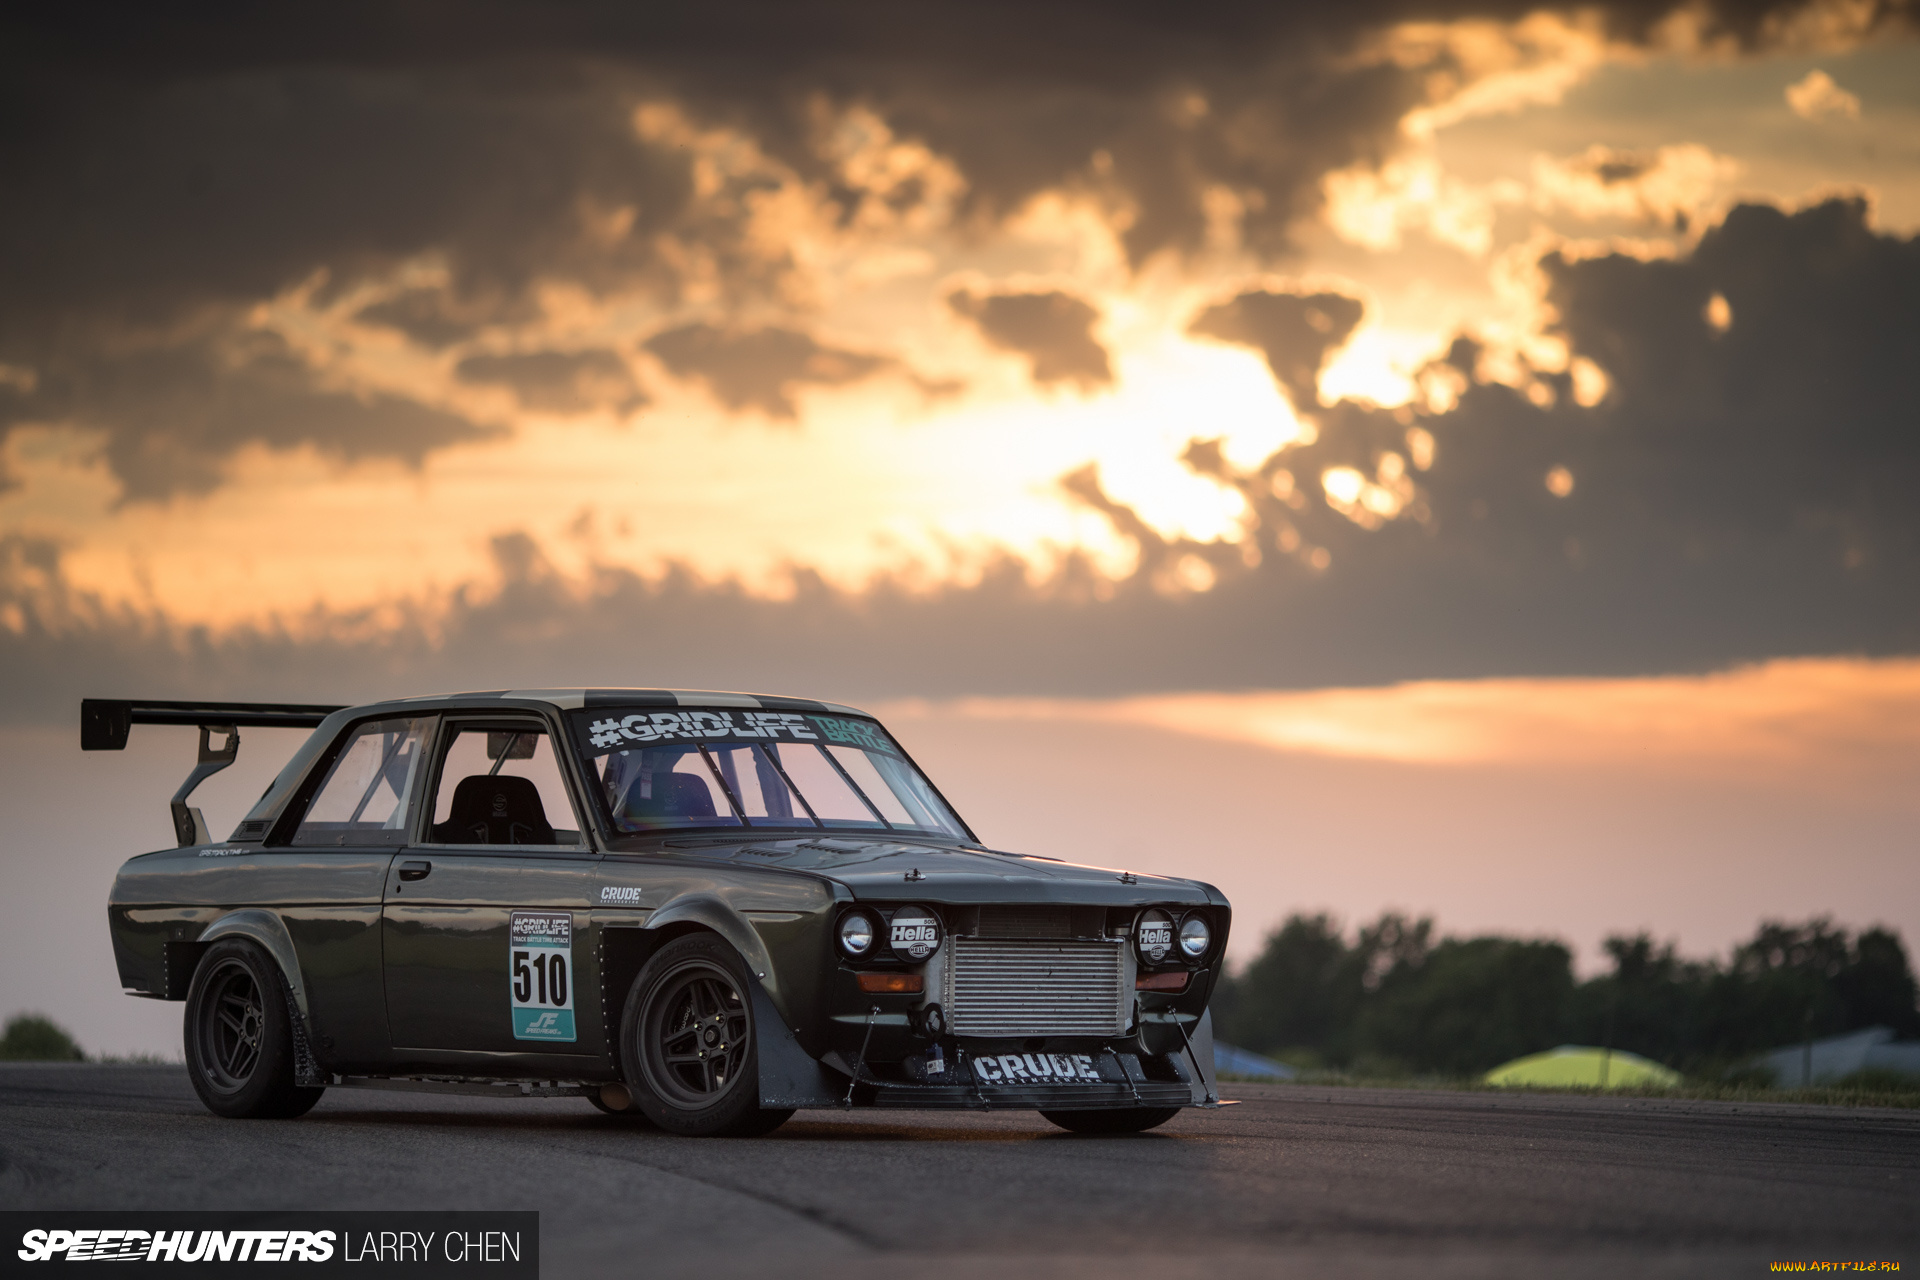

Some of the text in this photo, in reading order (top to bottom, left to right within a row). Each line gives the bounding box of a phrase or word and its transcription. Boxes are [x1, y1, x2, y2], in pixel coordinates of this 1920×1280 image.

[589, 712, 819, 748] #GRIDLIFE
[805, 715, 878, 738] TRACK
[823, 729, 897, 755] BATTLE
[601, 887, 642, 900] CRUDE
[513, 918, 569, 935] #GRIDLIFE
[890, 926, 936, 941] Hella
[1139, 929, 1171, 944] Hella
[513, 951, 567, 1007] 510
[973, 1053, 1100, 1080] CRUDE
